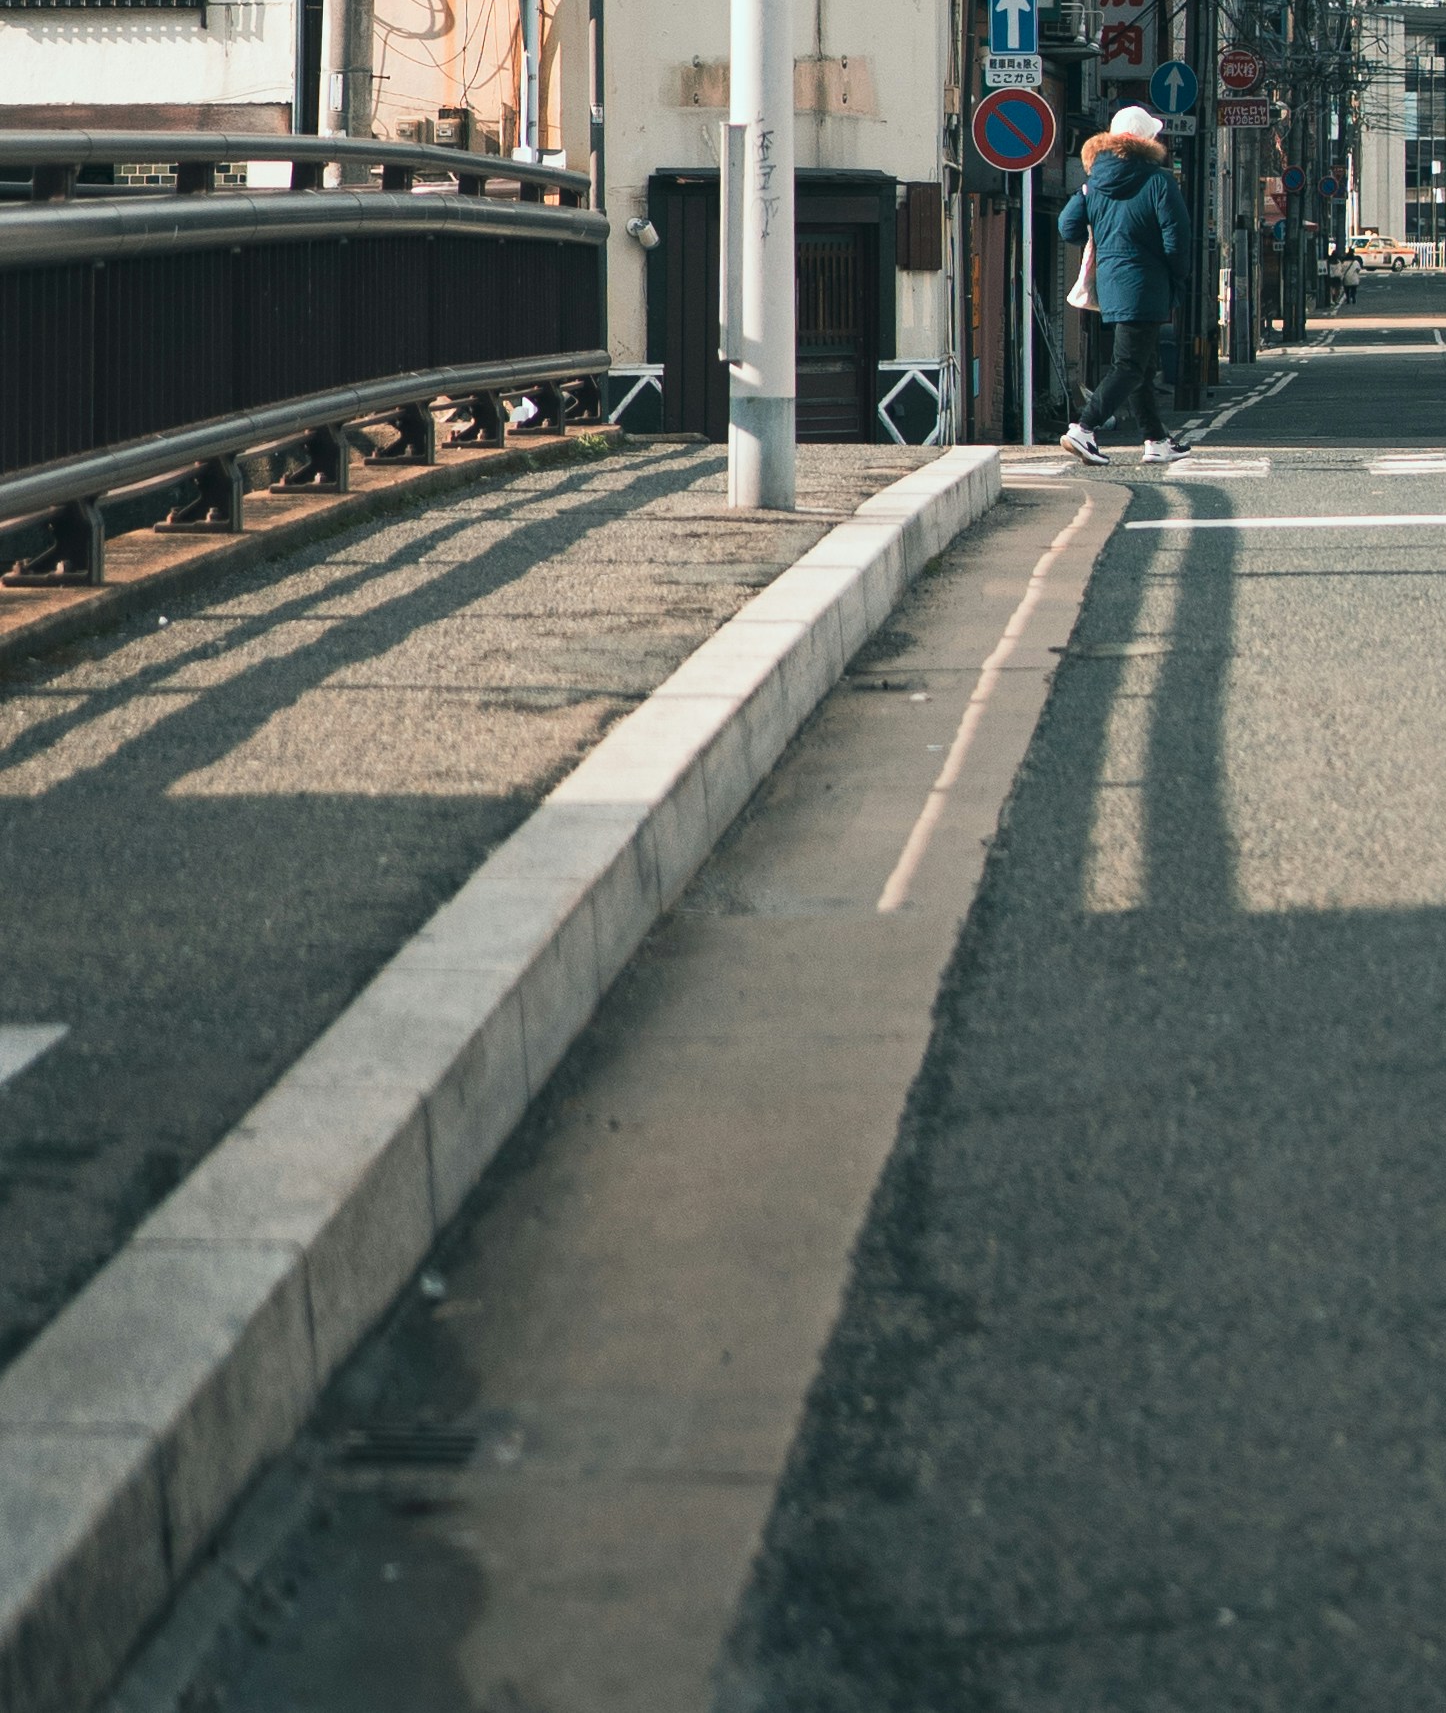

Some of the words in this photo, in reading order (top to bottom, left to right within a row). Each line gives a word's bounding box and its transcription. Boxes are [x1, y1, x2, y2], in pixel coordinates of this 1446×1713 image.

[989, 58, 1039, 70] 軽車両を除く
[1223, 62, 1255, 78] 消火栓
[992, 73, 1036, 84] ここから
